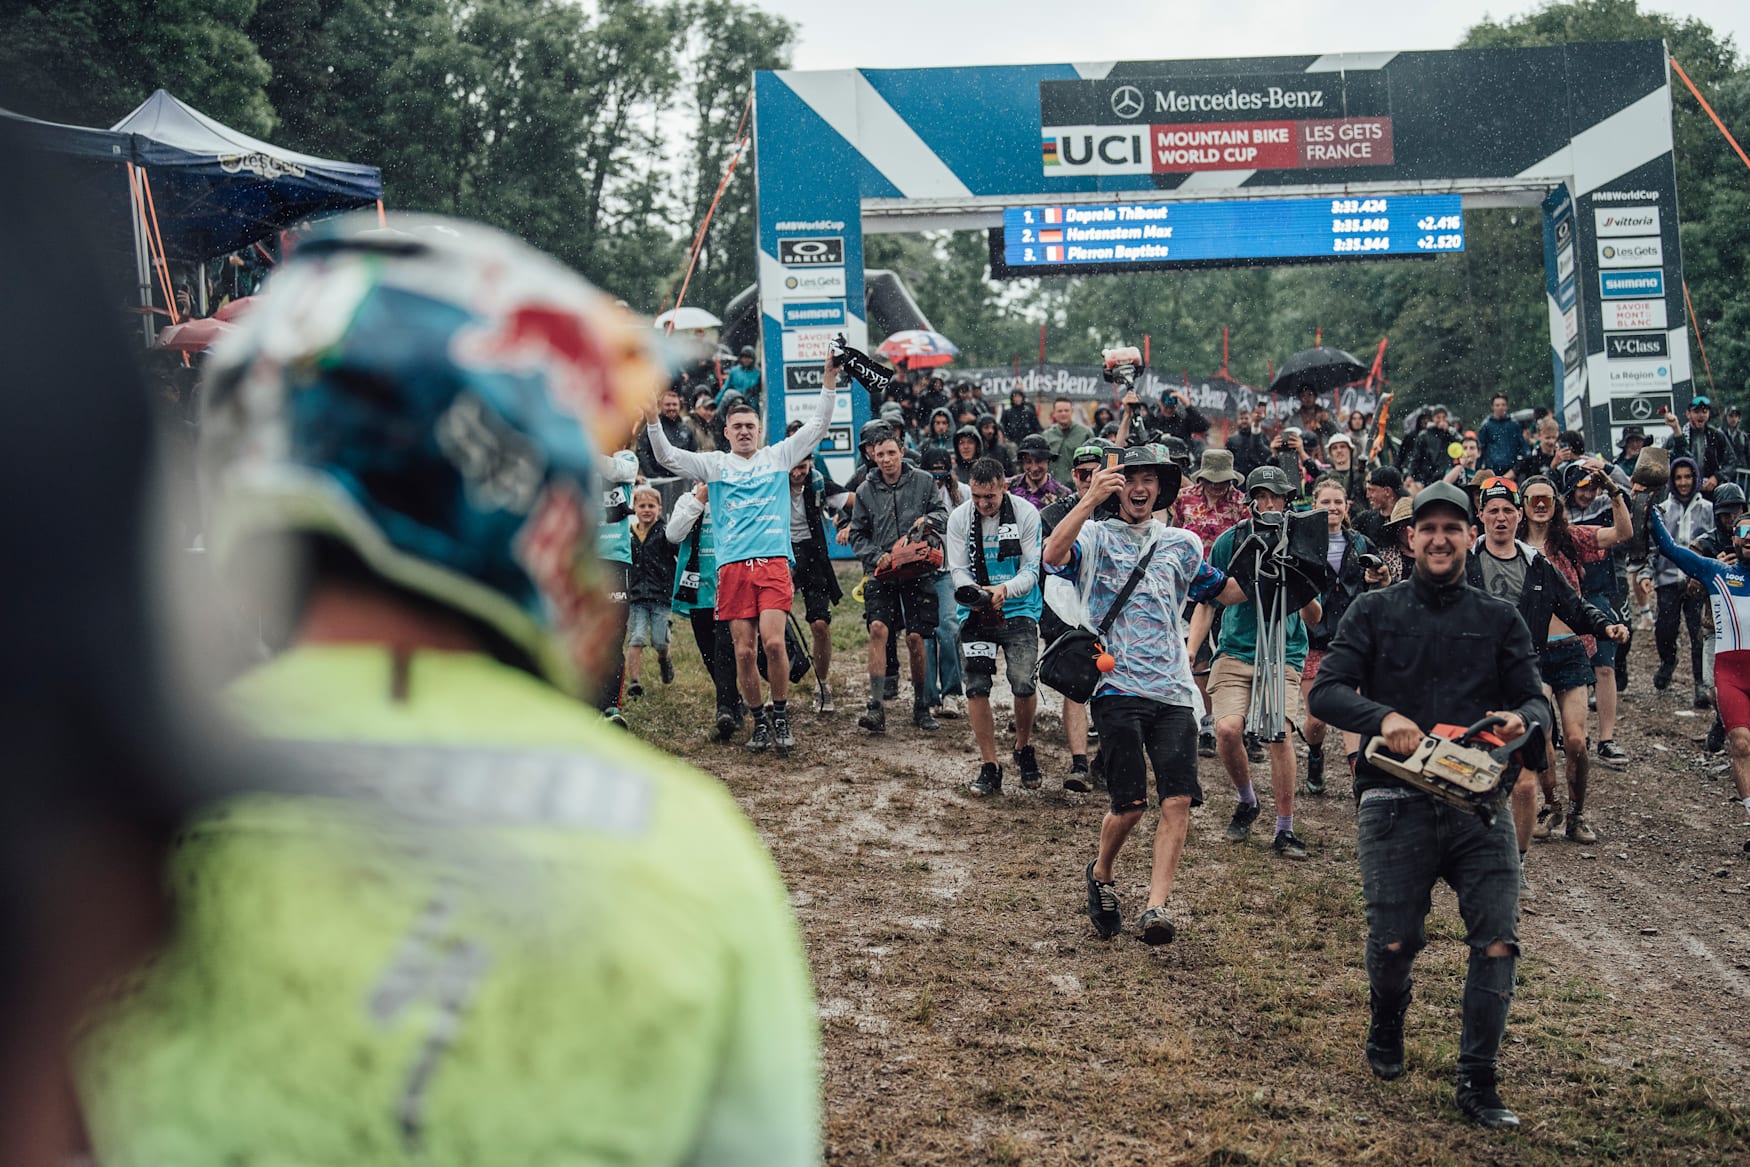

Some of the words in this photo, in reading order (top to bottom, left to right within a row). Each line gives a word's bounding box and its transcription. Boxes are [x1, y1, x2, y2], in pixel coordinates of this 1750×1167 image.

[1154, 88, 1323, 113] Mercedes-Benz
[1158, 130, 1250, 147] MOUNTAIN
[1252, 128, 1289, 143] BIKE
[1305, 125, 1335, 143] LES
[1338, 123, 1383, 140] GETS
[1061, 135, 1142, 166] UCI
[1158, 149, 1218, 165] WORLD
[1219, 147, 1258, 163] CUP
[1306, 142, 1372, 161] FRANCE
[1592, 190, 1659, 201] #MBWorldCup
[775, 219, 845, 232] #MBWorldCup
[1614, 216, 1654, 227] vittoria
[1143, 225, 1173, 239] Max
[1616, 248, 1634, 257] Les
[1634, 246, 1658, 256] Gets
[784, 254, 837, 263] OAKLEY
[1605, 277, 1658, 290] SHIMANO
[1616, 302, 1651, 311] SAVOIE
[787, 308, 842, 321] SHIMANO
[1616, 311, 1645, 319] MONT
[1617, 319, 1652, 328] BLANC
[798, 332, 832, 341] SAVOIE
[798, 342, 826, 350] MONT
[1613, 340, 1661, 353] V-Class
[798, 350, 827, 359] BLAN
[1609, 371, 1622, 380] La
